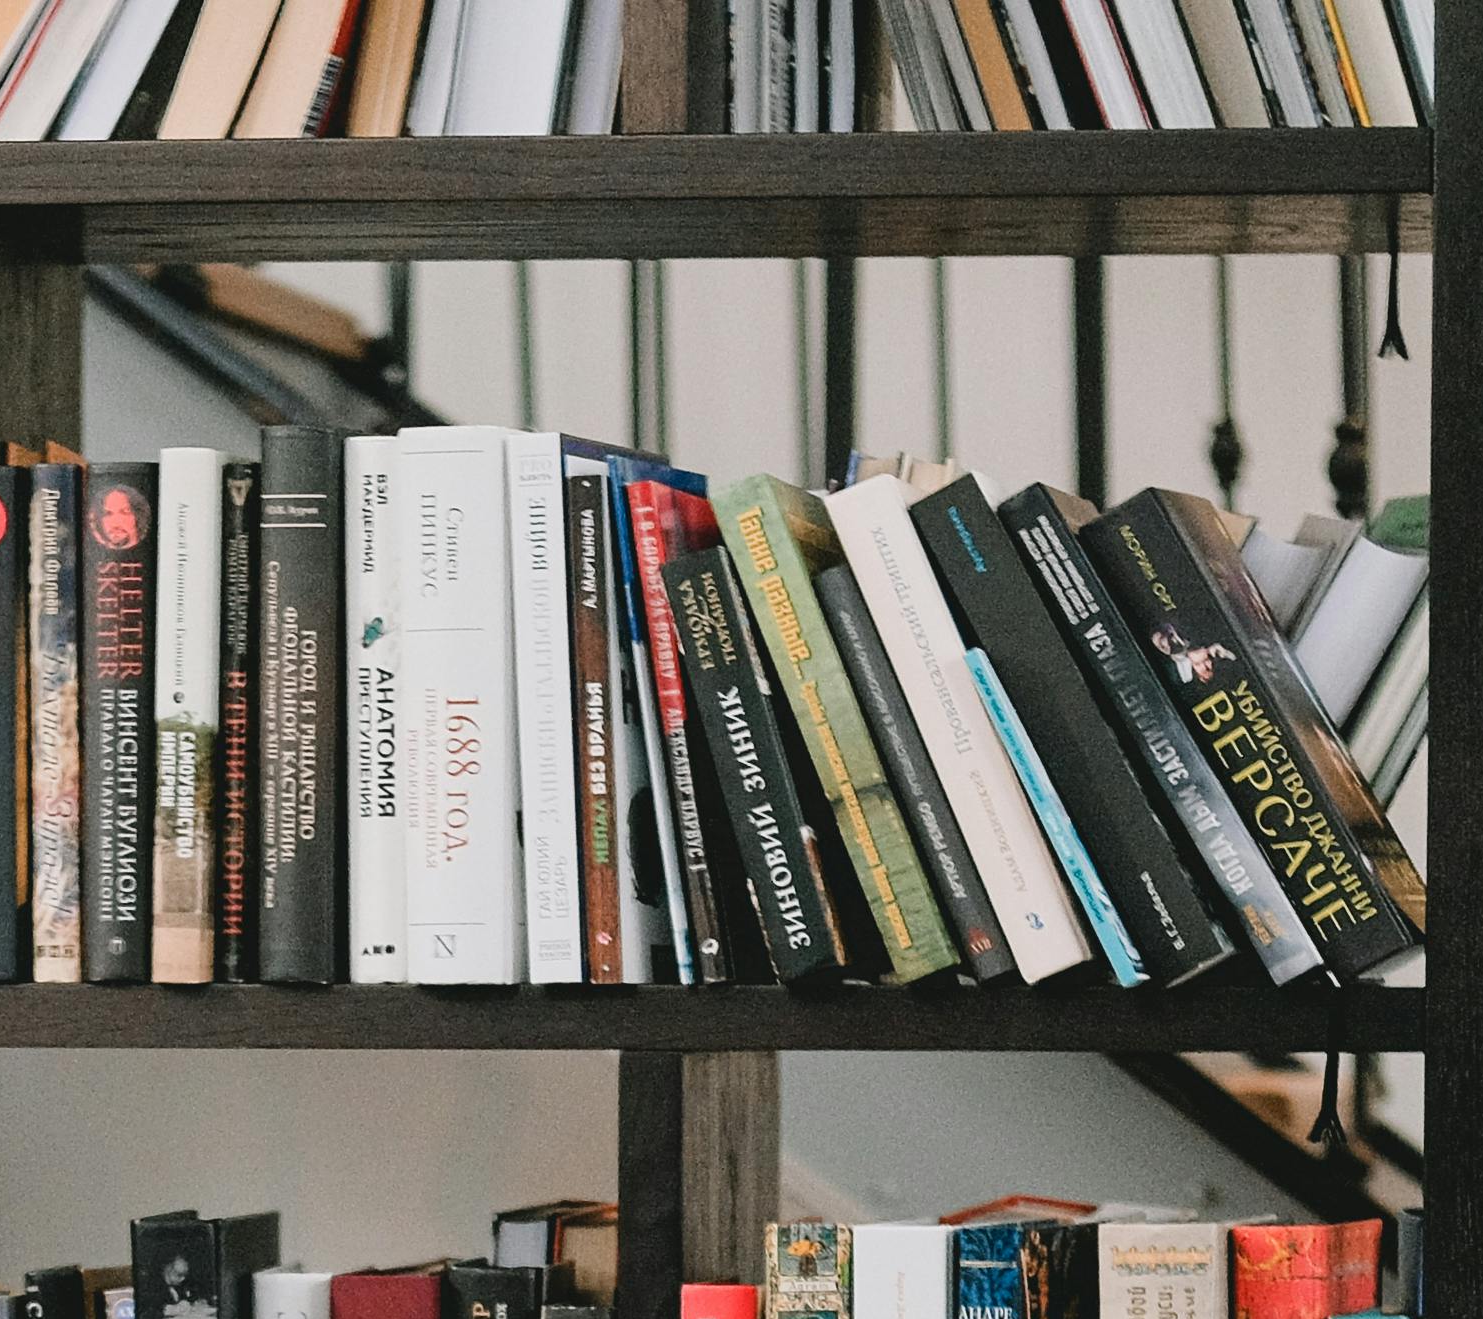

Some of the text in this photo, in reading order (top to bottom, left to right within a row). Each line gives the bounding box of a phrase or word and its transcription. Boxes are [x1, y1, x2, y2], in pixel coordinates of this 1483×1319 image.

[361, 474, 374, 573] МАКДЕРМИД
[376, 474, 387, 506] ВЭЛ
[420, 494, 436, 597] ПИНКУС
[444, 507, 464, 581] Стивен
[736, 505, 782, 575] Такие
[98, 561, 119, 679] SKELTER
[120, 562, 142, 679] HELTER
[1117, 522, 1177, 615] МОРИН ОРТ
[280, 606, 299, 739] ФЕОДАЛЬНОЙ
[868, 523, 976, 756] Провансальский триптих
[161, 731, 176, 807] ИМПЕРИИ
[176, 731, 196, 858] САМОУБИЙСТВО
[297, 629, 316, 839] ГОРОД И РЫЦАРСТВО
[358, 666, 372, 818] ПРЕСТУПЛЕНИЯ
[376, 666, 395, 818] АНАТОМИЯ
[445, 696, 480, 777] 1688
[584, 682, 609, 863] НЕПАЛ БЕЗ ВРАНЬЯ
[663, 706, 695, 796] АЛЕКСАНДР
[1081, 619, 1255, 897] КОГДА ДЫМ ЗАСТИЛАЕТ ГЛАЗА
[116, 690, 137, 922] ВИНСЕНТ БУГЛИОЗИ
[223, 670, 248, 934] В ТЕНИ ИСТОРИИ
[716, 684, 812, 952] ЗИНОВИЙ ЗИНИК
[915, 798, 967, 900] АРТЮР РЕМБО
[1190, 686, 1359, 945] ВЕРСАЧЕ
[1227, 674, 1319, 813] УБИЙСТВО
[1298, 806, 1379, 926] ДЖАННИ
